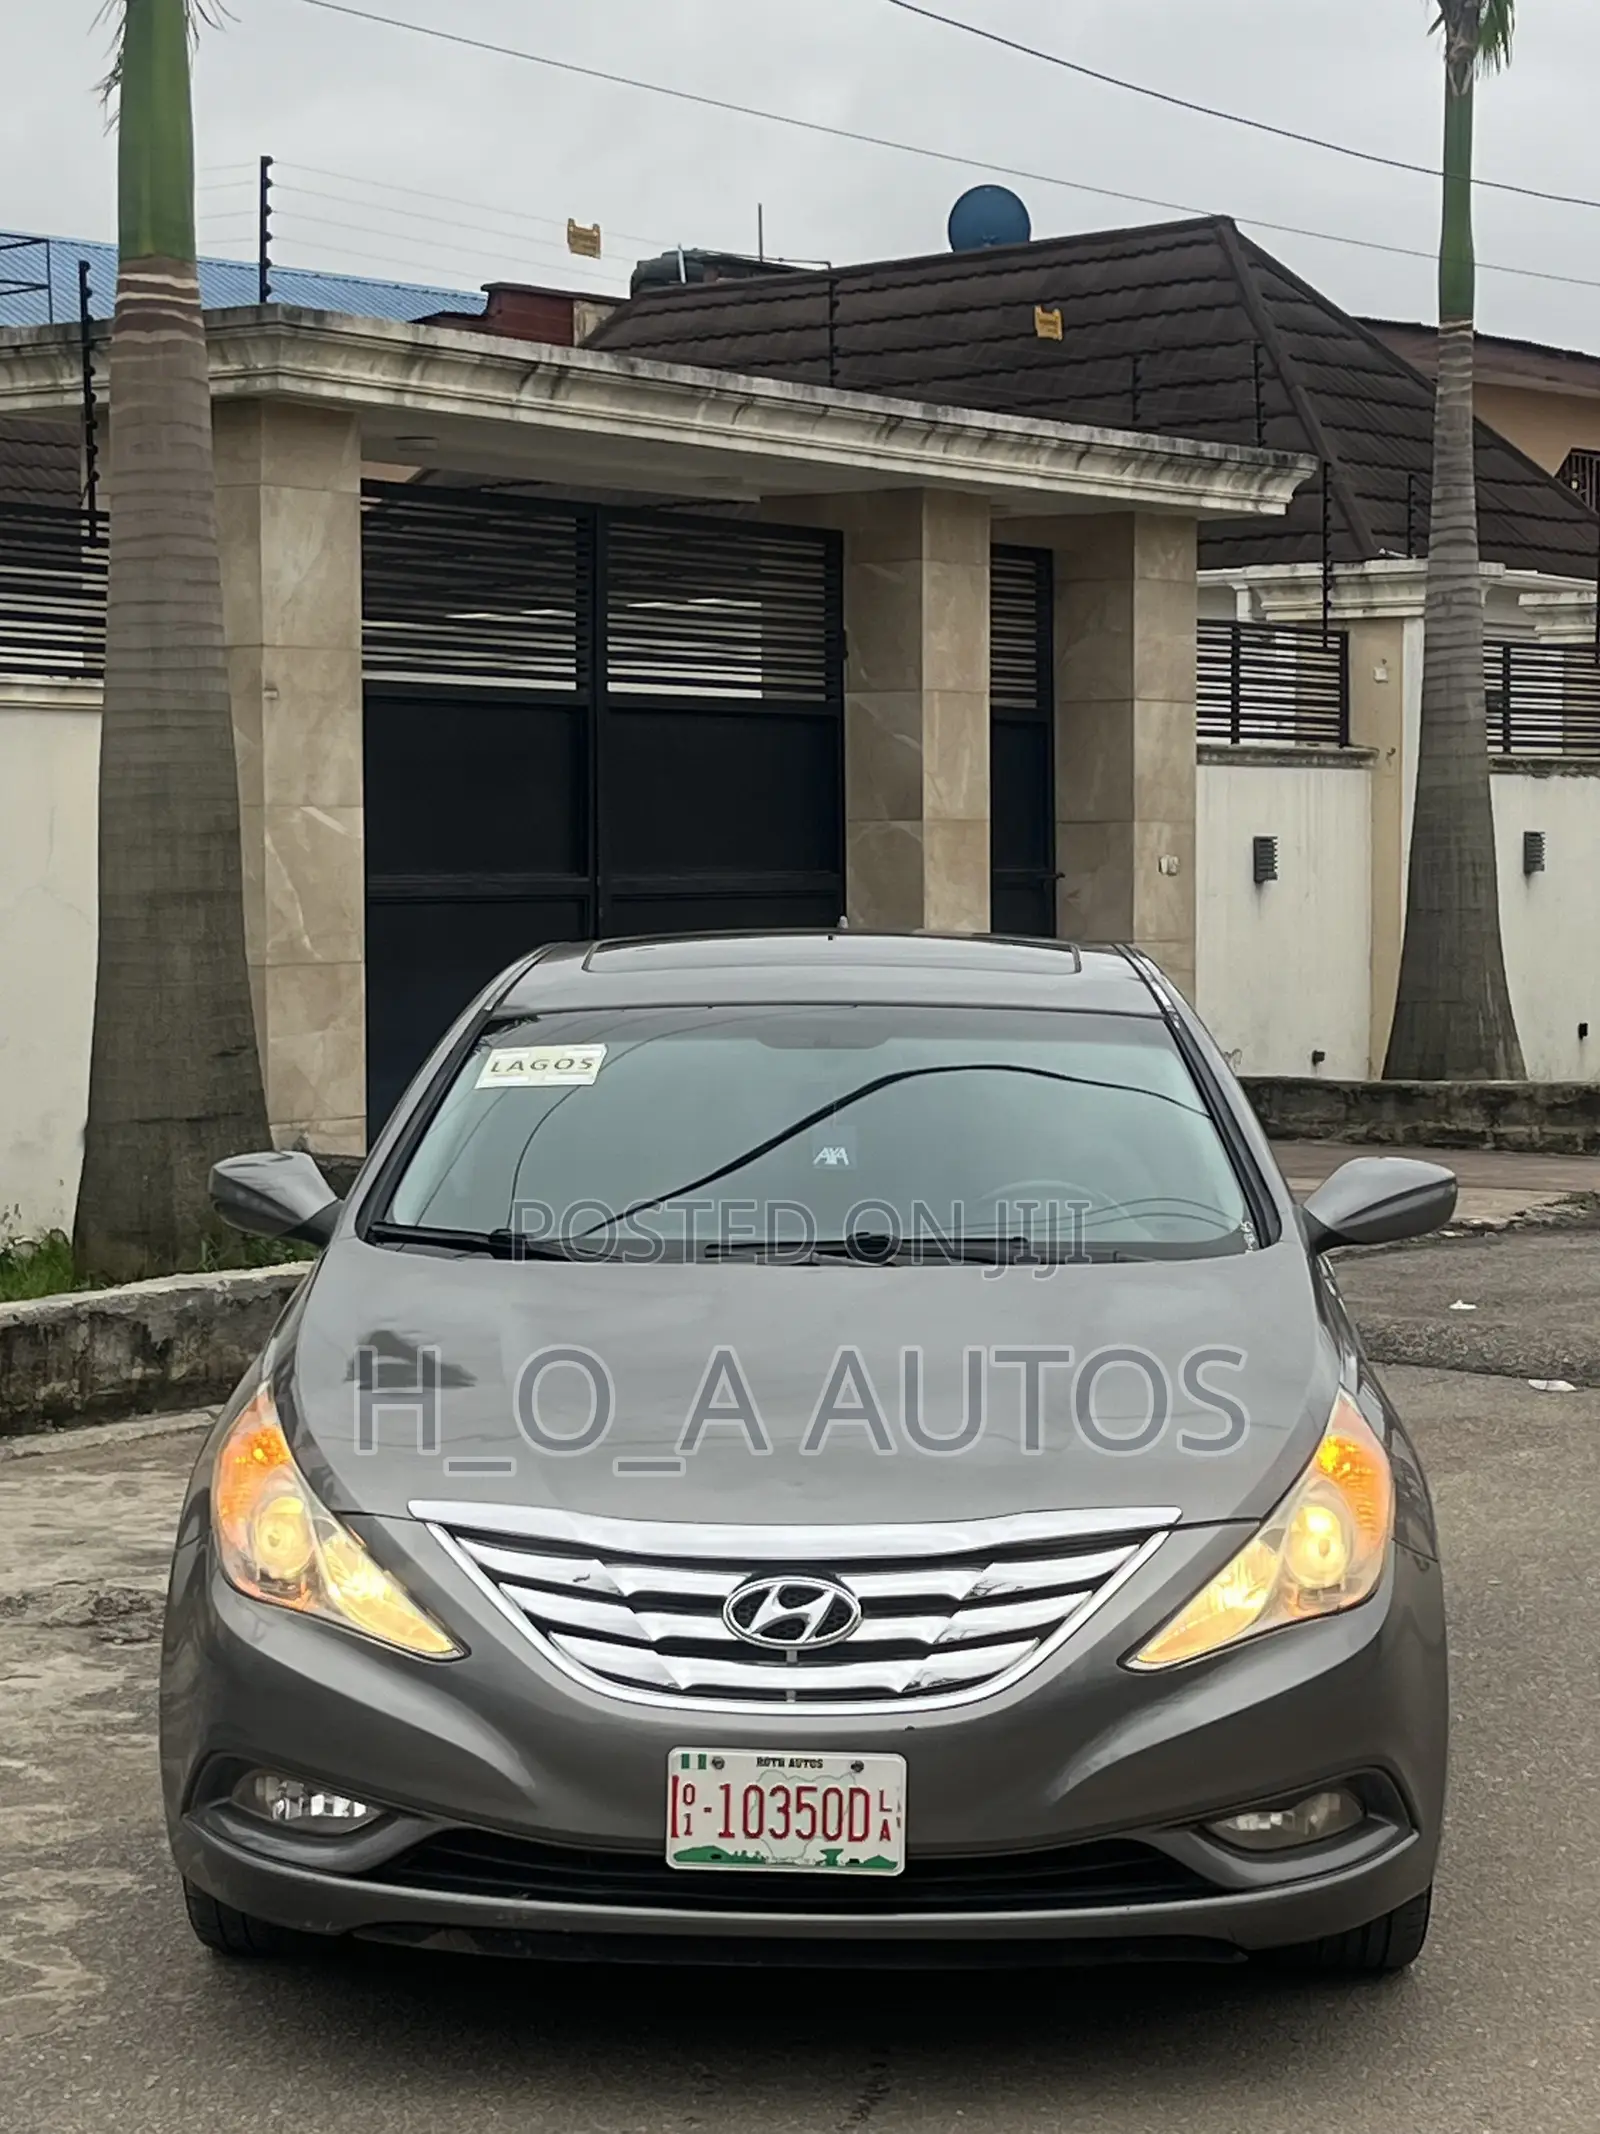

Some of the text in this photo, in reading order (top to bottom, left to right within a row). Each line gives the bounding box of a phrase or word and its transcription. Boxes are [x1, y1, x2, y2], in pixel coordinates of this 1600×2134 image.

[490, 1057, 594, 1073] LAGOS
[813, 1147, 849, 1166] AXA
[756, 1756, 823, 1769] ROTH AUTOS
